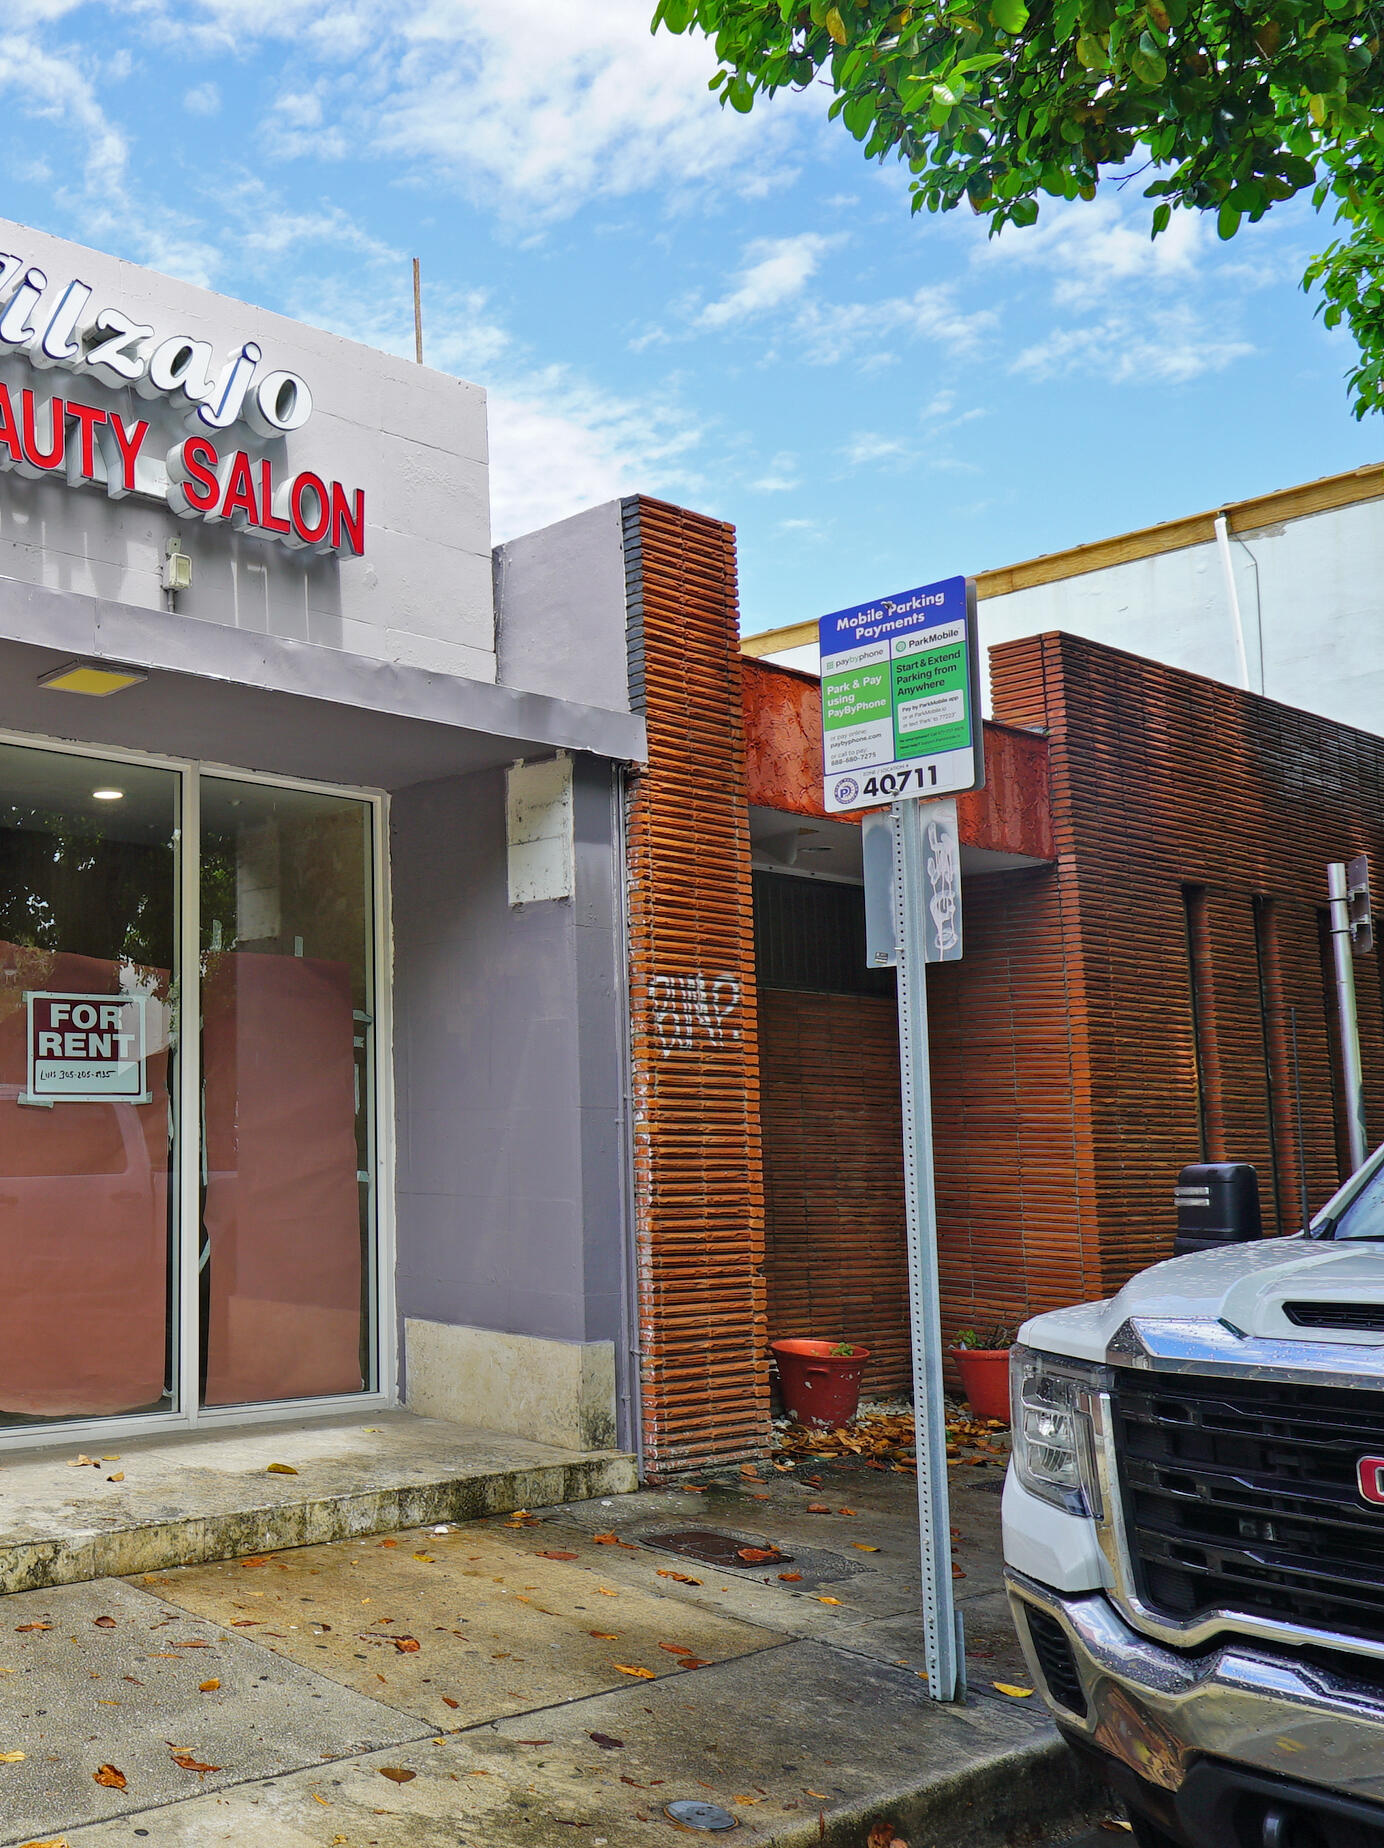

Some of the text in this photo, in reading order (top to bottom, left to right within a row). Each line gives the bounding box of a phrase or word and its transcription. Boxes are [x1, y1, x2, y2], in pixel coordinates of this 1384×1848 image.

[179, 435, 365, 557] SALON
[836, 592, 945, 631] Mobile Parking
[855, 612, 926, 640] Payments
[908, 629, 959, 648] ParkMobile
[835, 649, 884, 668] paybyphone
[896, 649, 961, 673] Start & Extend
[827, 675, 882, 696] Park & Pay
[896, 664, 957, 685] Parking from
[897, 679, 945, 697] Anywhere
[827, 694, 855, 707] using
[827, 699, 887, 719] PayByPhone
[862, 764, 937, 797] 40711
[50, 1002, 123, 1030] FOR
[38, 1031, 136, 1058] RENT
